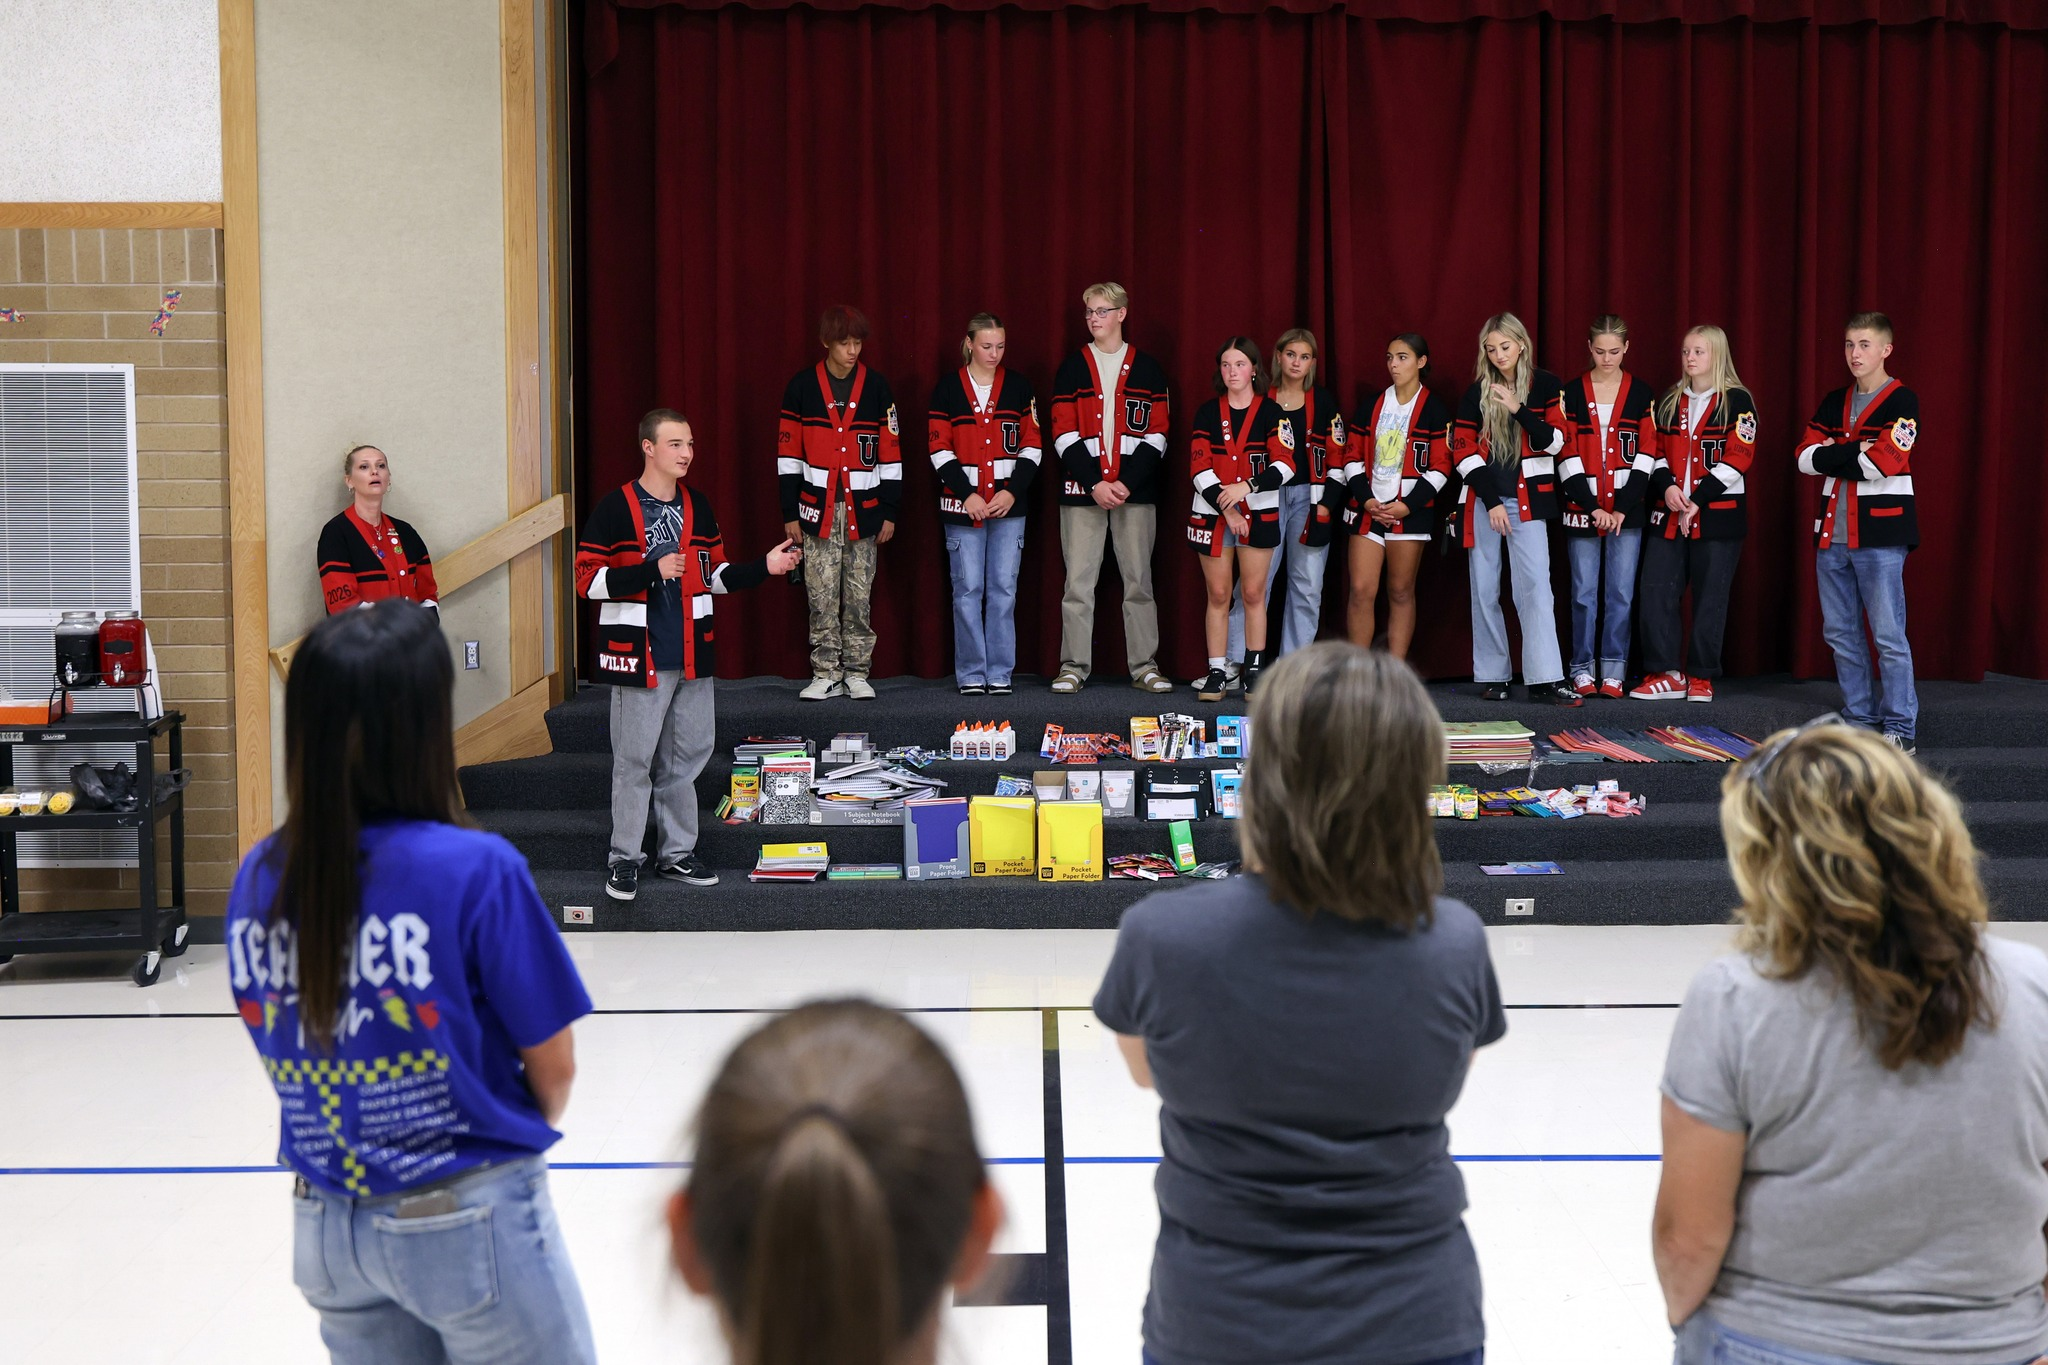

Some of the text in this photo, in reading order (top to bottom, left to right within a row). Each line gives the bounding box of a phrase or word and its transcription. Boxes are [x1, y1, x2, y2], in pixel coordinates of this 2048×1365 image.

[1125, 399, 1152, 433] U
[857, 434, 880, 467] U
[1002, 422, 1020, 455] U
[1618, 431, 1639, 464] U
[1312, 445, 1326, 479] U
[1413, 441, 1430, 475] U
[1701, 439, 1727, 472] U
[1563, 511, 1589, 528] MAE
[698, 551, 712, 589] U
[327, 584, 352, 605] 2026
[599, 653, 640, 673] WILLY
[230, 912, 434, 991] TEAER
